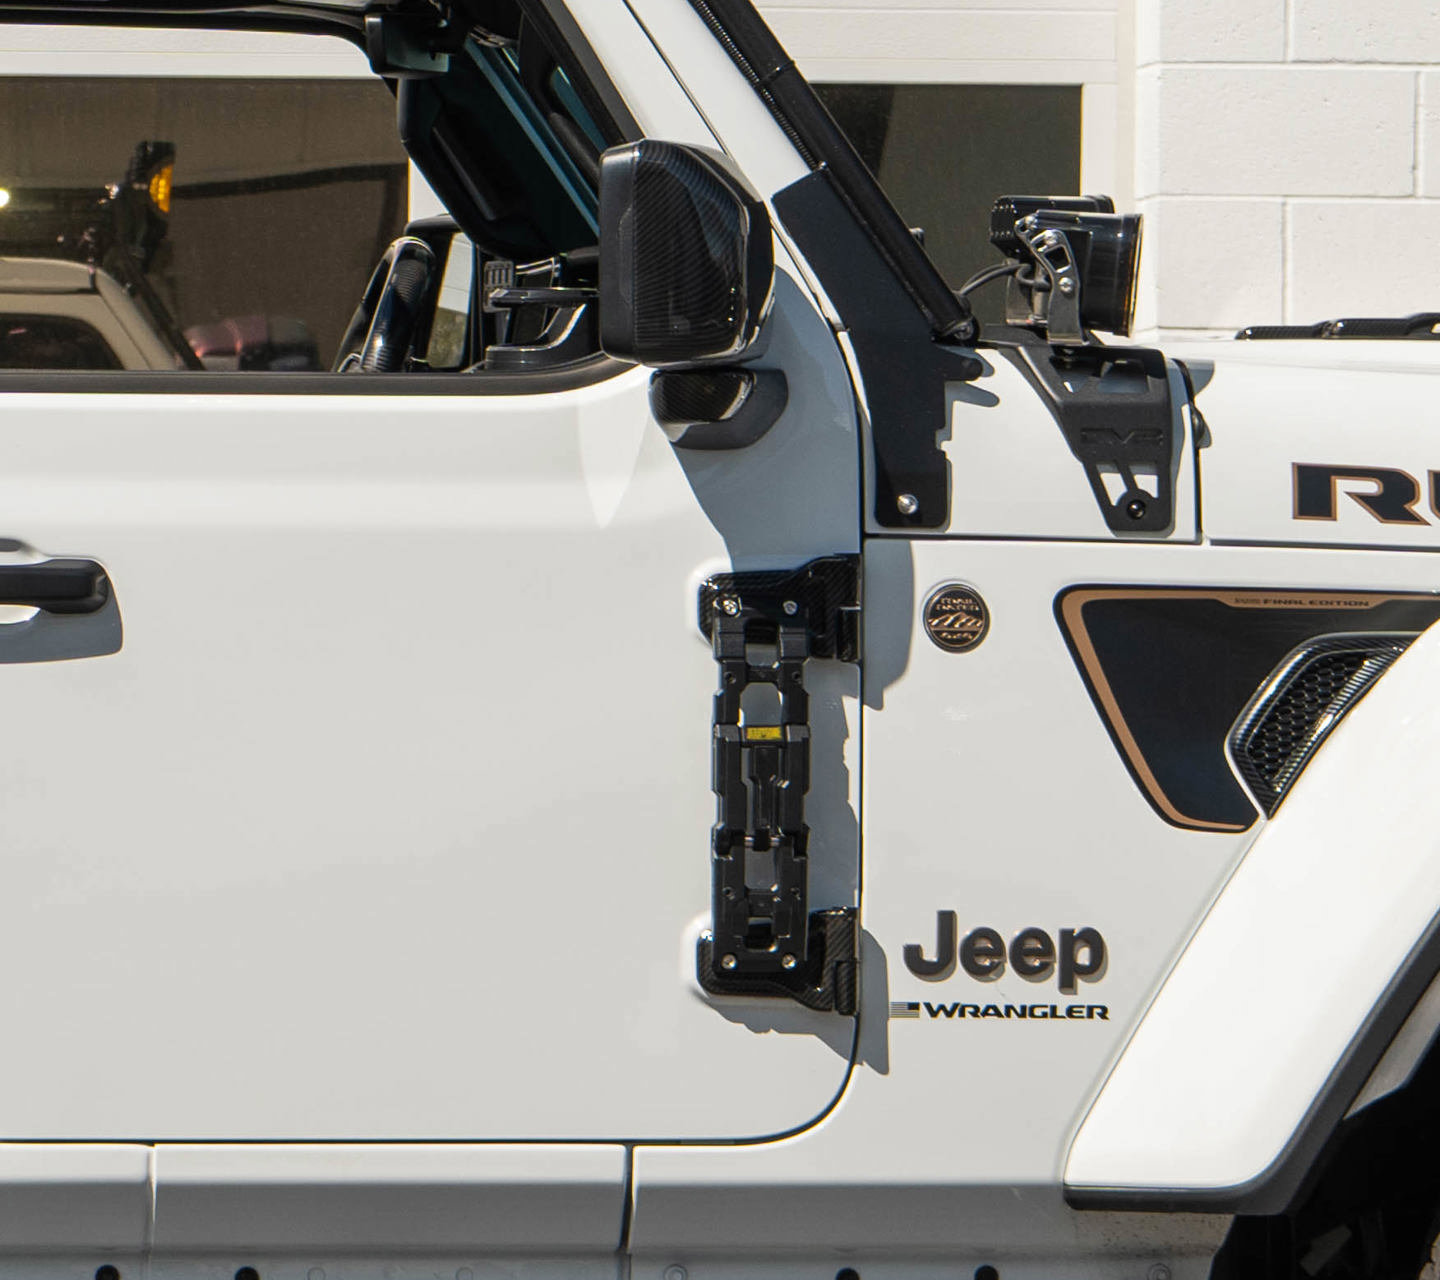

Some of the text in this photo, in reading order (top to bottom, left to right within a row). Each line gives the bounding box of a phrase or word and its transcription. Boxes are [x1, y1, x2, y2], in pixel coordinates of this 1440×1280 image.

[1263, 598, 1304, 606] FINAL
[1309, 599, 1369, 607] EDITION
[904, 910, 1106, 993] Jeep
[923, 1002, 1110, 1020] WRANGLER
